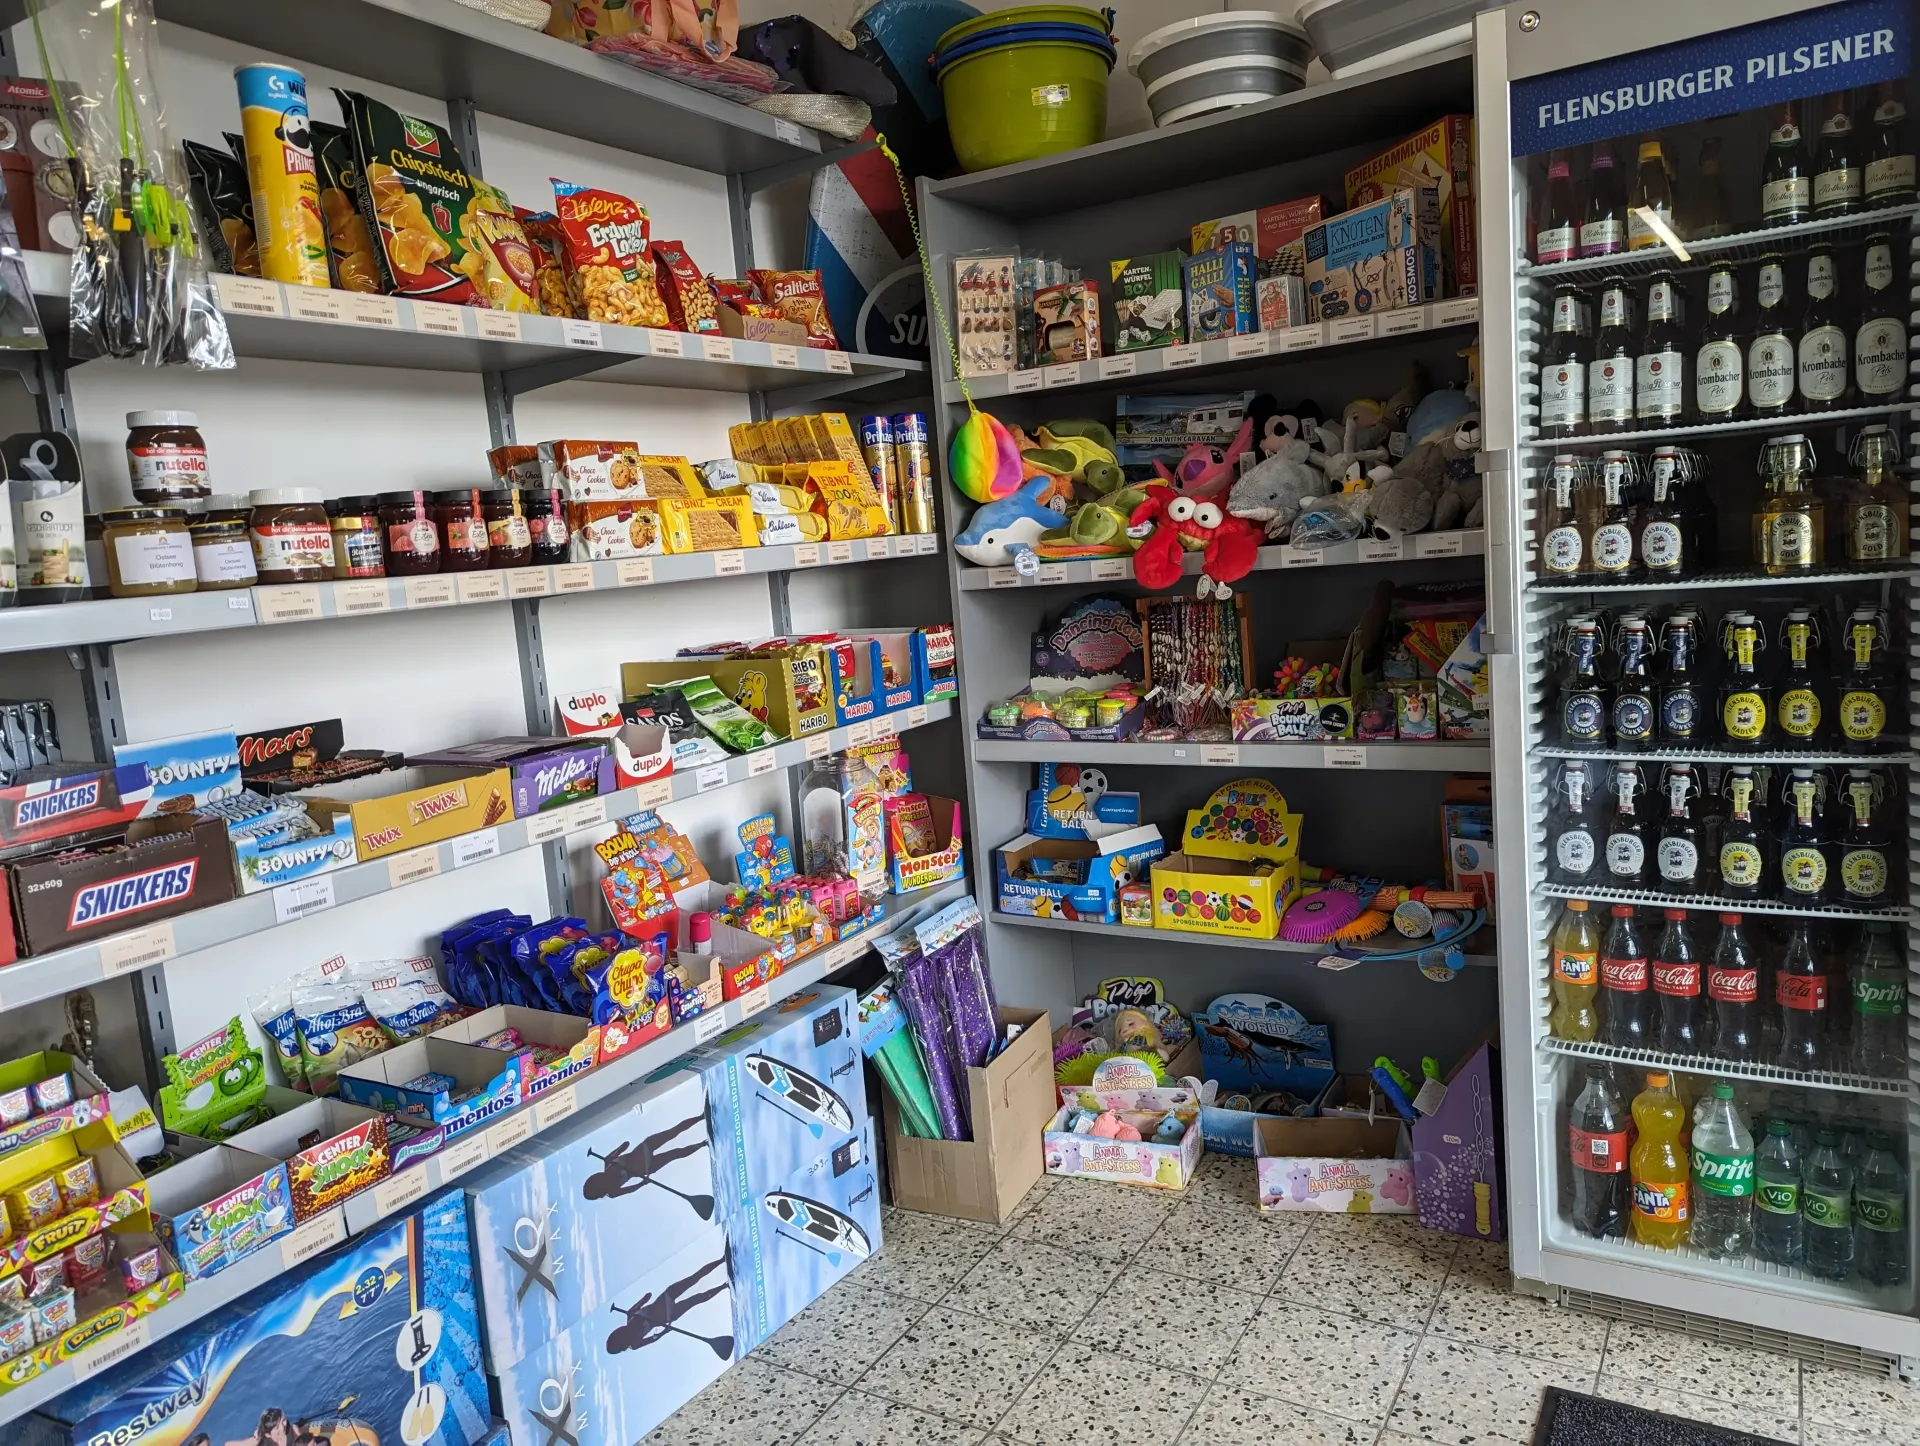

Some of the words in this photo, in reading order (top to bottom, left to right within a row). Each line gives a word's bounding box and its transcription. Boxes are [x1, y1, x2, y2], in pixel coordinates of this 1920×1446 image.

[1538, 64, 1735, 130] FLENSBURGER
[1746, 28, 1895, 84] PILSENER
[8, 85, 44, 96] Atomic
[410, 122, 434, 140] frisch
[1348, 127, 1441, 189] SPIELESAMMLUNG
[390, 149, 469, 189] Chipsfrisch
[415, 178, 461, 202] ungarisch
[1264, 223, 1278, 231] UND
[1190, 257, 1223, 278] HALLI
[1404, 247, 1418, 304] KOSMOS
[1123, 273, 1152, 284] WÜRFEL
[1191, 269, 1224, 290] GALLI
[773, 281, 820, 300] Saltletts
[1124, 283, 1153, 297] BOX
[744, 320, 776, 341] Lorenz
[1801, 356, 1847, 373] Krombacher
[1857, 350, 1906, 366] Krombacher
[1150, 435, 1164, 444] CAR
[1165, 434, 1182, 443] WITH
[1183, 434, 1217, 443] CARAVAN
[155, 458, 206, 472] nutella
[656, 455, 682, 465] CREAM
[579, 466, 596, 475] Choco
[586, 474, 607, 484] Cookies
[816, 475, 852, 489] LEIBNIZ
[829, 488, 851, 500] ZOO
[670, 499, 705, 512] LEIBNIZ
[716, 496, 744, 508] CREAM
[27, 523, 73, 533] GESCHIRRTUCH
[600, 527, 616, 537] Choco
[768, 519, 797, 533] Bahlsen
[280, 533, 330, 551] nutella
[606, 535, 626, 545] Cookies
[1547, 530, 1582, 549] FLENSBURGER
[1595, 527, 1629, 550] FLENSBURGER
[1644, 525, 1678, 547] FLENSBURGER
[1780, 549, 1801, 558] GOLD
[1862, 543, 1884, 552] GOLD
[155, 552, 177, 561] Ostsee
[1549, 556, 1577, 569] PILSENER
[1597, 554, 1627, 566] PILSENER
[1645, 551, 1675, 566] PILSENER
[149, 561, 184, 570] Blütenhonig
[926, 632, 955, 650] HARIBO
[932, 680, 956, 694] HARIBO
[568, 692, 607, 711] duplo
[885, 690, 912, 707] HARIBO
[1567, 697, 1601, 714] FLENSBURGER
[1615, 698, 1650, 715] FLENSBURGER
[1663, 692, 1698, 710] FLENSBURGER
[1726, 695, 1764, 714] FLENSBURGER
[1780, 692, 1818, 710] FLENSBURGER
[1842, 695, 1881, 713] FLENSBURGER
[844, 701, 874, 720] HARIBO
[1271, 712, 1314, 726] BOUNCY
[800, 714, 828, 732] HARIBO
[1276, 722, 1307, 738] BALL
[1572, 724, 1597, 735] DUNKEL
[1619, 725, 1645, 736] DUNKEL
[1669, 720, 1695, 731] DUNKEL
[1731, 725, 1758, 735] RADLER
[1786, 722, 1813, 732] RADLER
[1847, 725, 1875, 736] RADLER
[238, 725, 314, 768] Mars
[859, 740, 900, 757] WUNDERBALL
[148, 754, 232, 787] BOUNTY
[632, 755, 663, 773] duplo
[534, 755, 587, 799] Milka
[1214, 780, 1251, 799] SPONGE
[1252, 780, 1283, 803] RUBBER
[1228, 790, 1268, 807] BALLS
[19, 783, 97, 825] SNICKERS
[416, 791, 460, 820] Twix
[628, 812, 649, 825] CANDY
[1053, 809, 1093, 820] RETURN
[1061, 819, 1087, 829] BALL
[362, 826, 403, 851] Twix
[596, 831, 639, 862] BOUM
[1560, 834, 1593, 849] FLENSBURGER
[1608, 835, 1642, 851] FLENSBURGER
[1128, 852, 1150, 863] RETURN
[1149, 847, 1163, 858] BALL
[1659, 839, 1693, 857] FLENSBURGER
[1722, 844, 1759, 862] FLENSBURGER
[257, 844, 333, 877] BOUNTY
[900, 852, 959, 878] Monster
[1785, 851, 1823, 868] FLENSBURGER
[1845, 853, 1885, 871] FLENSBURGER
[1615, 865, 1632, 873] FREI
[1667, 870, 1685, 878] FREI
[27, 878, 63, 894] 32x50g
[901, 870, 944, 890] WUNDERBALL
[75, 864, 192, 923] SNICKERS
[1004, 883, 1038, 896] RETURN
[1039, 887, 1063, 899] BALL
[1172, 918, 1220, 929] SPONGERUBBER
[323, 957, 345, 973] NEU
[414, 960, 432, 971] NEU
[612, 959, 643, 977] Chupa
[1560, 958, 1591, 974] FANTA
[1601, 958, 1647, 983] Coca-Cola
[733, 964, 755, 985] BOUM
[374, 979, 397, 989] NEU
[426, 985, 441, 993] NEU
[1214, 1002, 1298, 1024] OCEAN
[1230, 1019, 1289, 1036] WORLD
[188, 1035, 223, 1060] CENTER
[185, 1040, 233, 1078] SHOCK
[529, 1055, 593, 1095] mentos
[1106, 1063, 1141, 1078] ANIMAL
[497, 1078, 514, 1096] mint
[1095, 1076, 1155, 1092] ANTI-STRESS
[407, 1103, 425, 1115] mint
[727, 1064, 743, 1144] PADDLEBOARD
[444, 1091, 516, 1138] mentos
[21, 1118, 62, 1144] CANDY
[317, 1134, 362, 1165] CENTER
[398, 1136, 443, 1163] Airwaves
[1092, 1144, 1128, 1160] ANIMAL
[310, 1142, 373, 1193] SHOCK
[735, 1146, 749, 1200] STAND-UP
[1082, 1158, 1142, 1174] ANTI-STRESS
[1319, 1163, 1360, 1177] ANIMAL
[1692, 1149, 1754, 1180] Sprite
[1308, 1174, 1375, 1193] ANTI-STRESS
[216, 1188, 256, 1216] CENTER
[1632, 1189, 1670, 1208] FANTA
[208, 1193, 266, 1238] SHOCK
[546, 1201, 567, 1276] MAX
[748, 1204, 764, 1283] PADDLEBOARD
[755, 1283, 768, 1337] STAND-UP
[88, 1372, 210, 1446] Bestway
